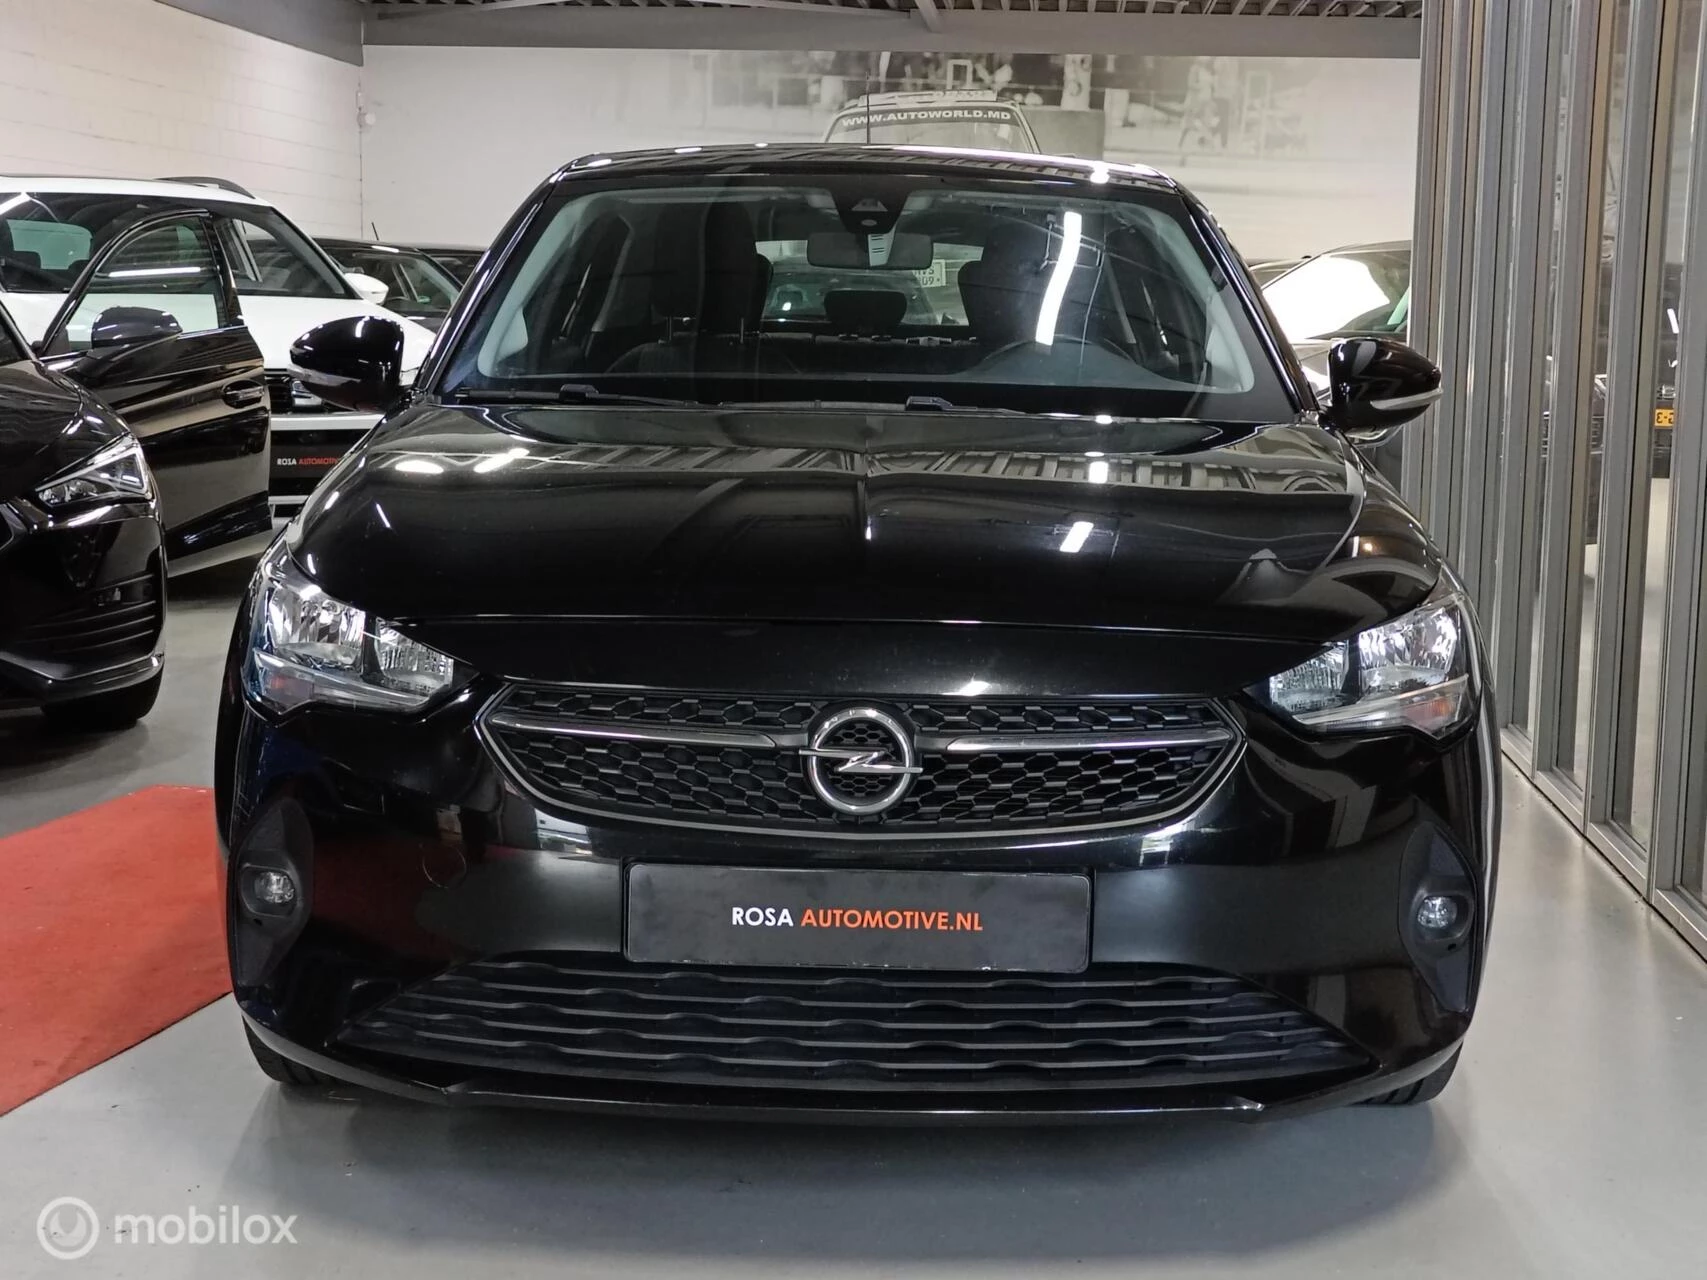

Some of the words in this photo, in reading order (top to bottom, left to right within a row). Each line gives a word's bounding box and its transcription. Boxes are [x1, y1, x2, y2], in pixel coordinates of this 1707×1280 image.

[277, 458, 297, 466] ROSA
[731, 907, 794, 927] ROSA
[801, 908, 983, 931] AUTOMOTIVE.NL
